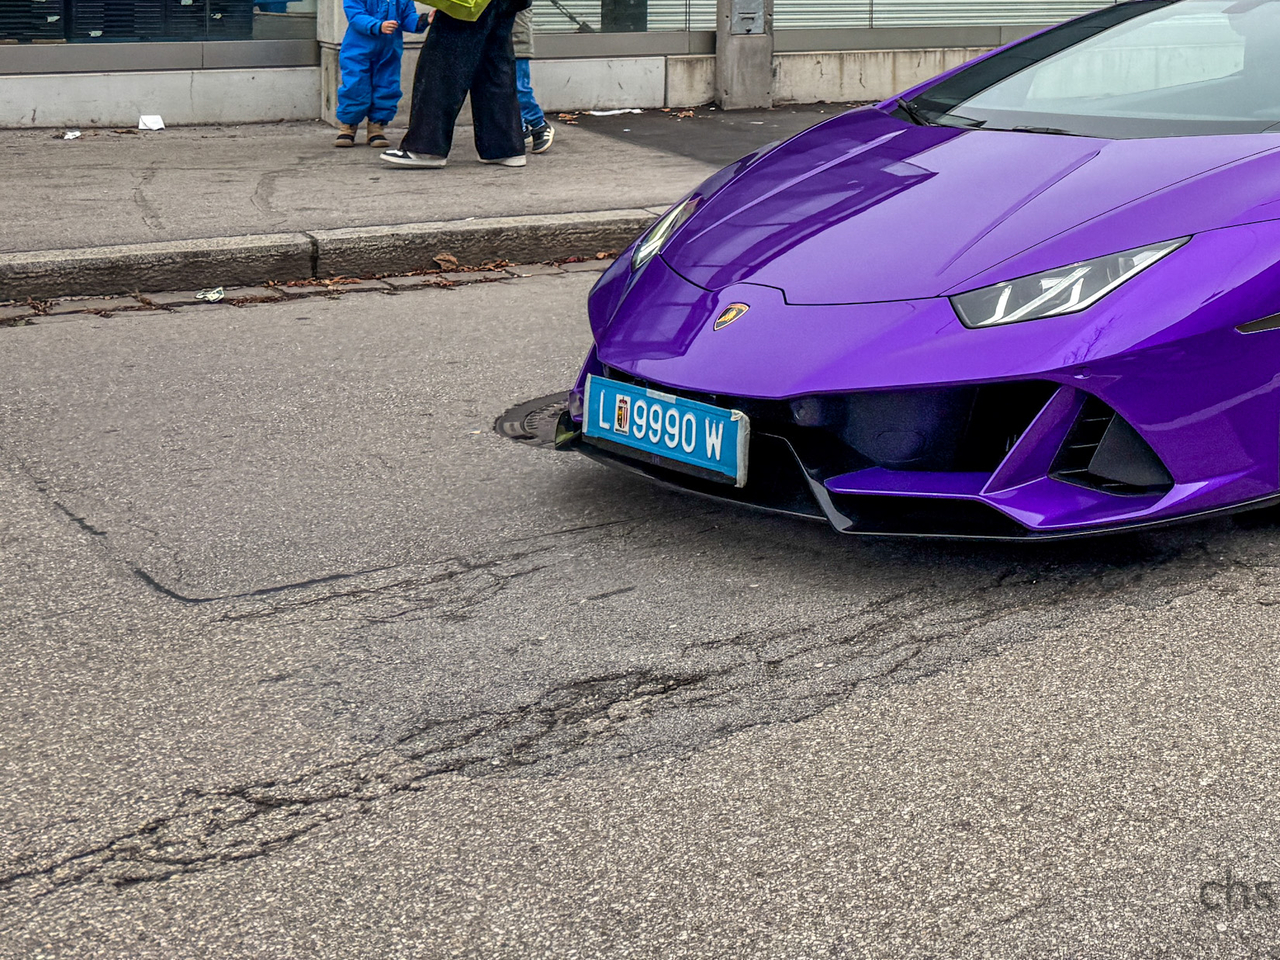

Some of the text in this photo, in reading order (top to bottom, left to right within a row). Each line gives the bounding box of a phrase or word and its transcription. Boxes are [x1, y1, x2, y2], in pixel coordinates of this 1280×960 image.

[599, 389, 725, 461] L 9990 W
